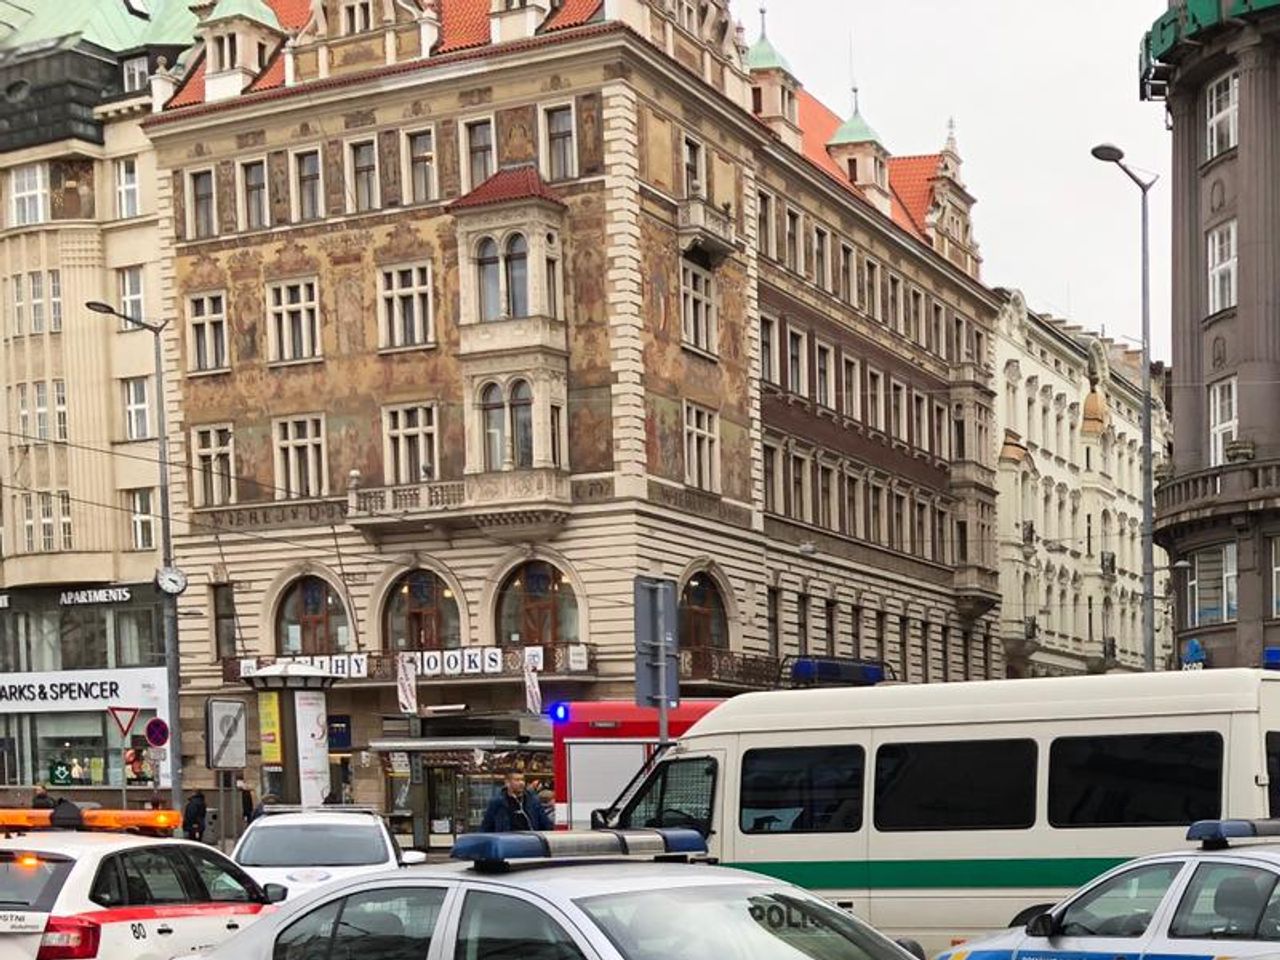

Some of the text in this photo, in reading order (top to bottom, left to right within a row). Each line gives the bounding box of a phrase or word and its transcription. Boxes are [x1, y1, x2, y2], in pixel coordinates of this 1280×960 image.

[60, 588, 131, 605] APARTMENTS
[414, 650, 499, 674] OOKS
[38, 685, 48, 701] &
[50, 681, 120, 701] SPENCER
[131, 923, 147, 939] 80
